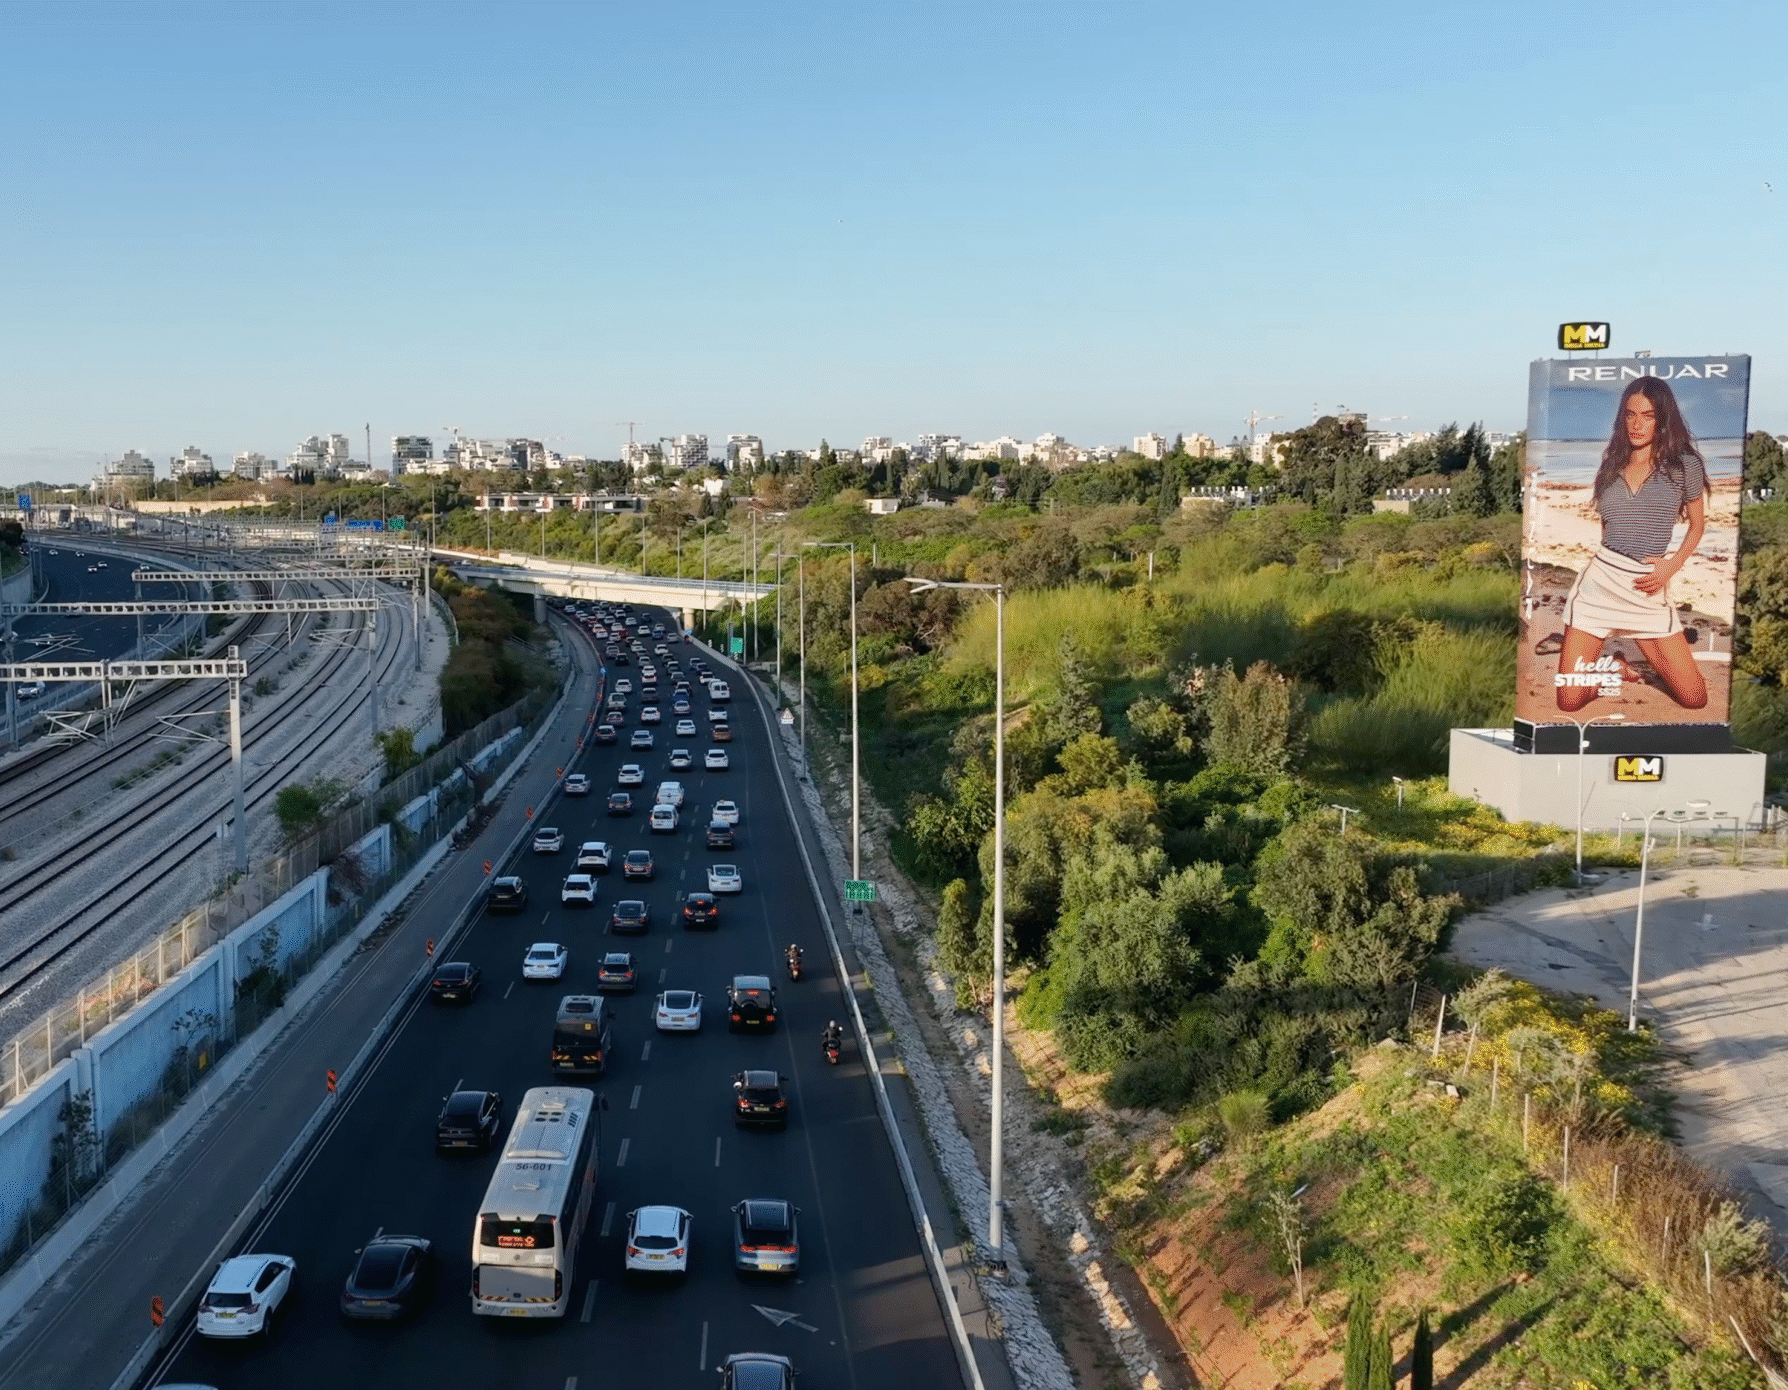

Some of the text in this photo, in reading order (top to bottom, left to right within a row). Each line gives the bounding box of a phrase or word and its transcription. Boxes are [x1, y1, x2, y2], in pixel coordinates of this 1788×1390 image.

[1564, 324, 1606, 343] MM
[1568, 363, 1729, 382] RENUAR
[1573, 655, 1623, 672] hello
[1554, 673, 1622, 687] STRIPES
[1618, 757, 1660, 775] MM
[515, 1162, 552, 1171] 56-601
